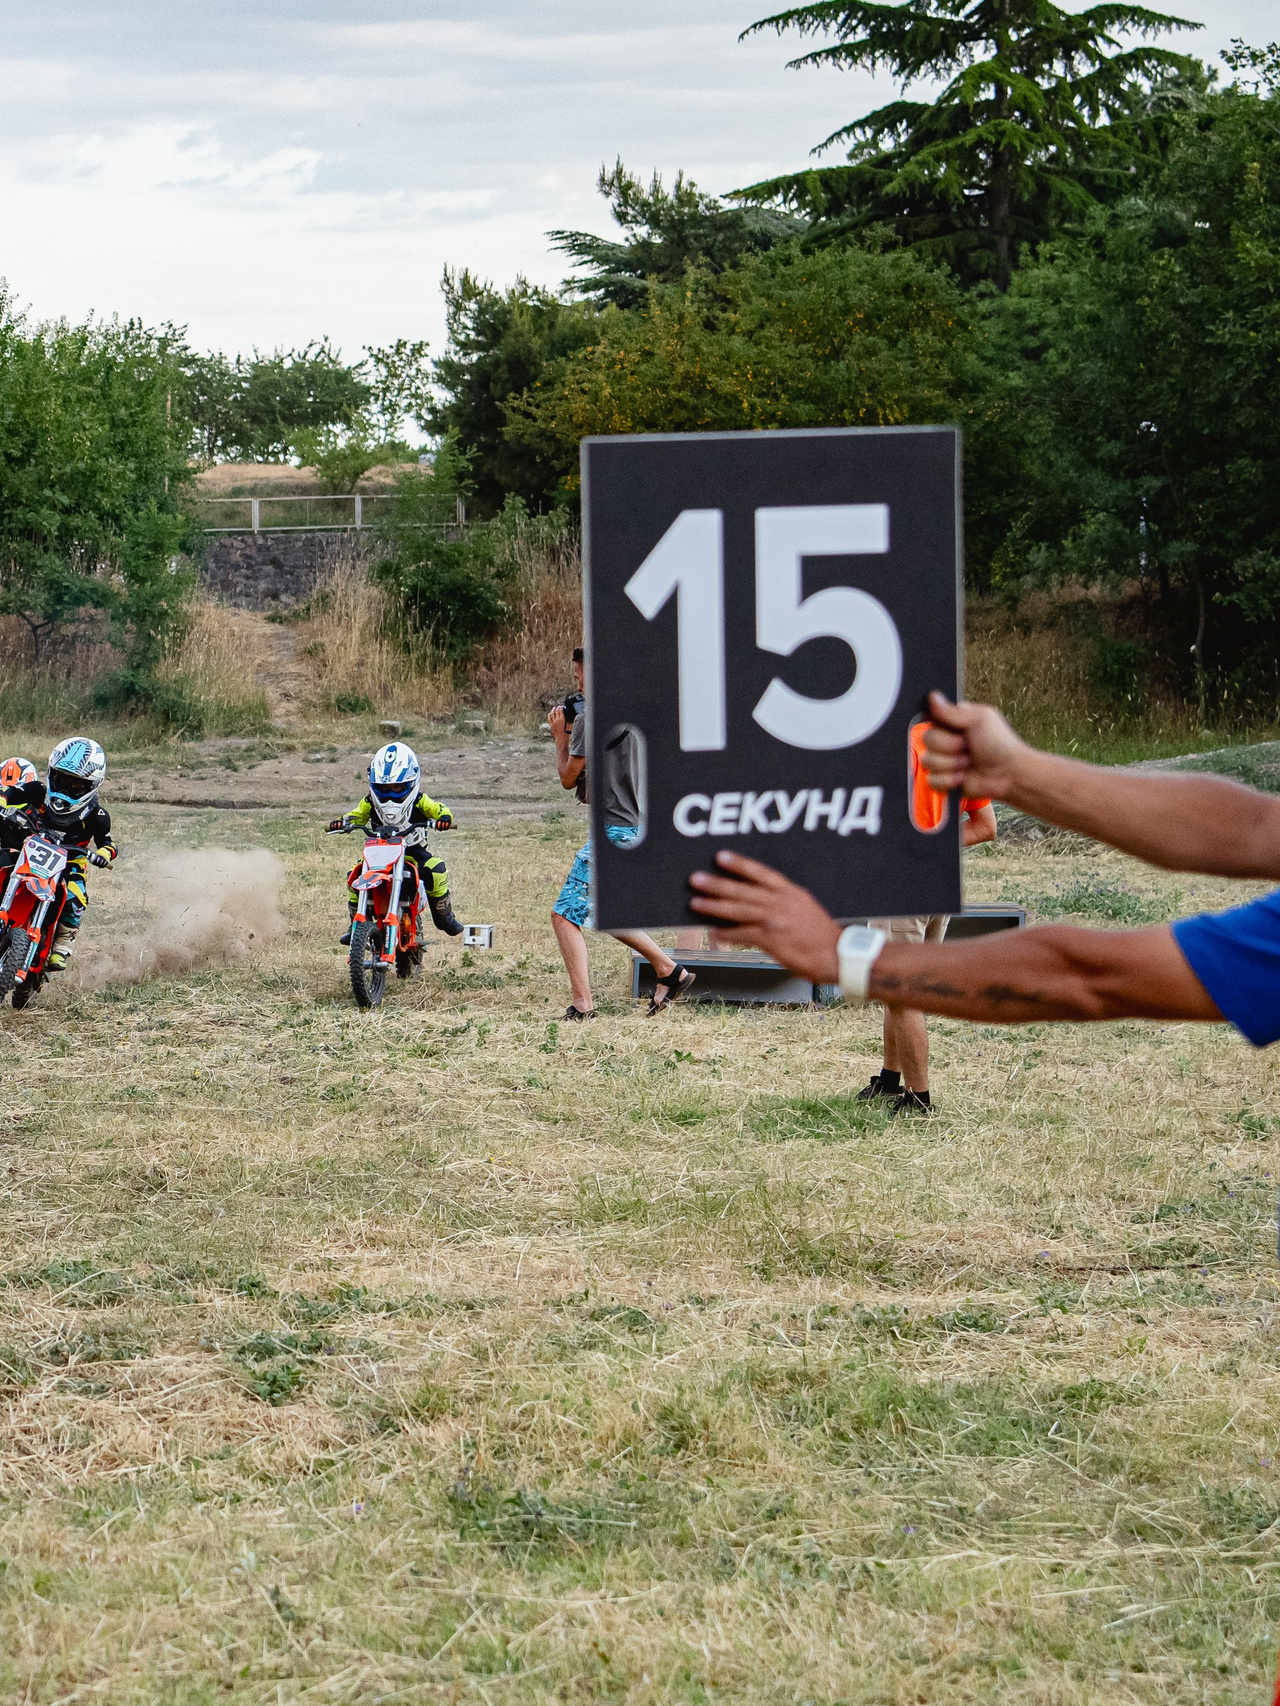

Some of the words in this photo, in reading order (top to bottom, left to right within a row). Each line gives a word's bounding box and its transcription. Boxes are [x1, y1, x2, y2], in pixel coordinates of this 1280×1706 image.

[623, 503, 904, 751] 15
[673, 786, 884, 836] СЕКУНД
[29, 846, 61, 871] 31
